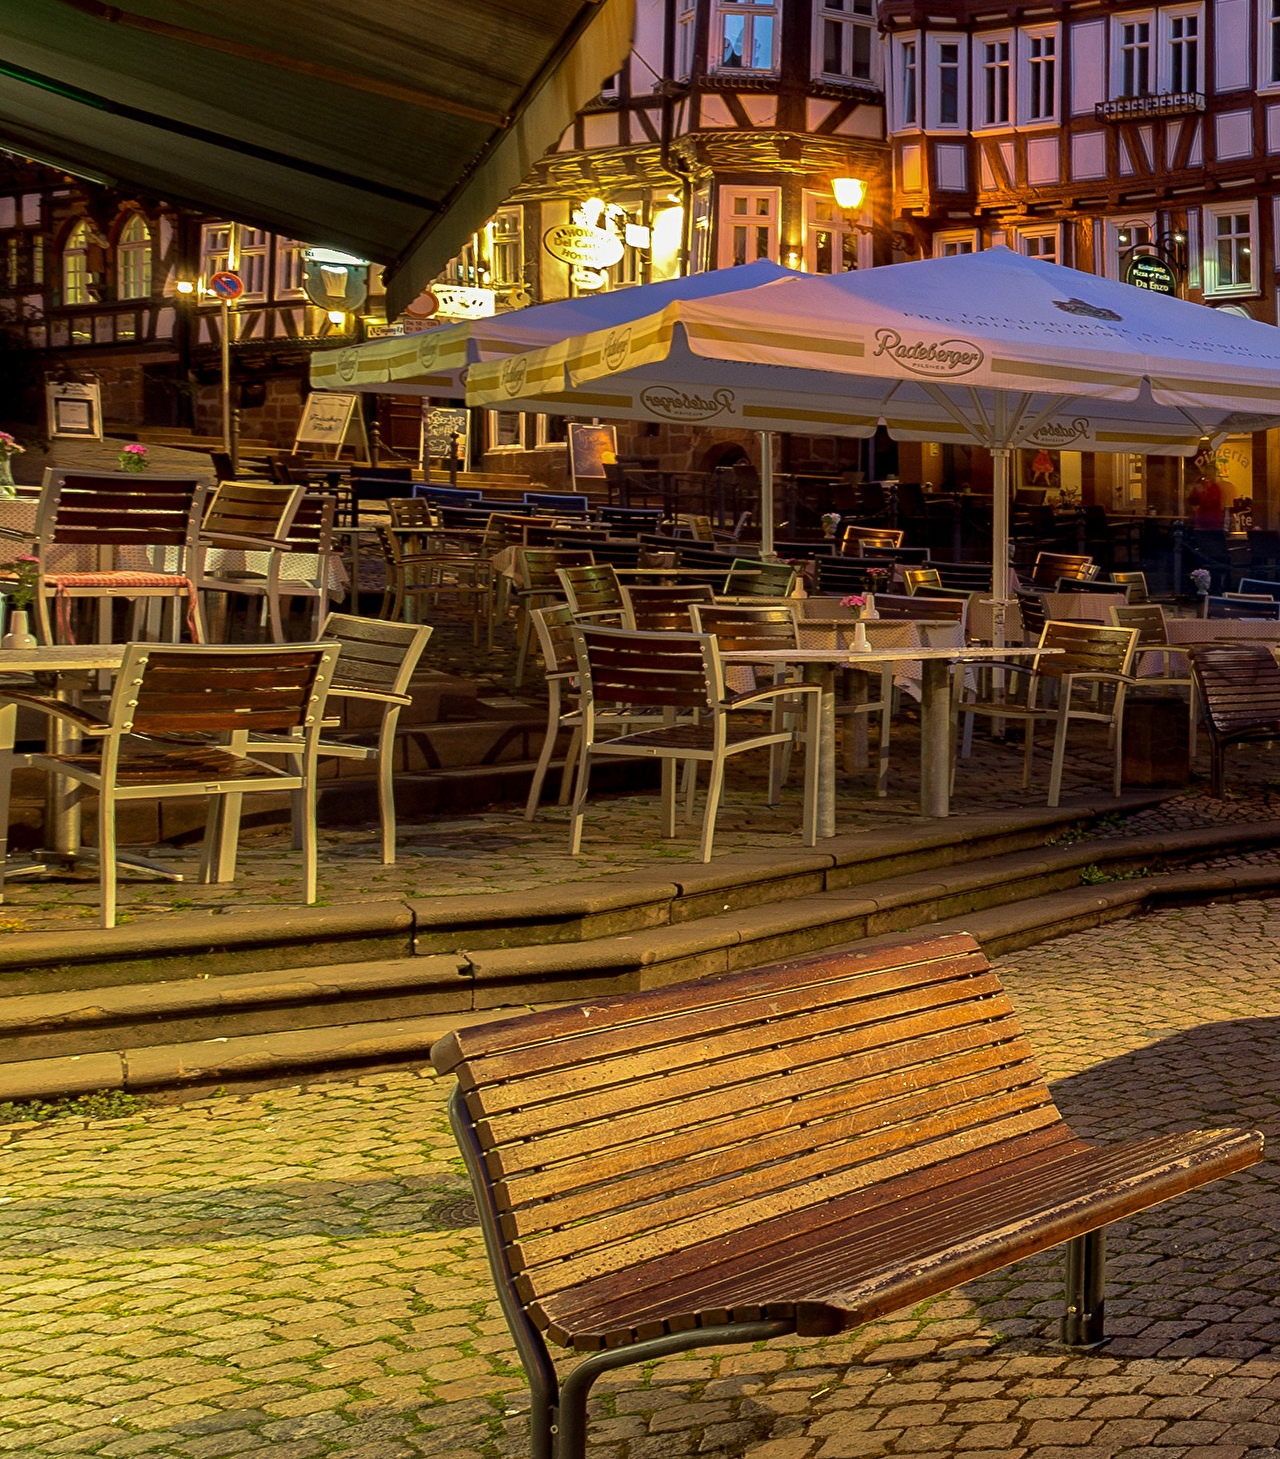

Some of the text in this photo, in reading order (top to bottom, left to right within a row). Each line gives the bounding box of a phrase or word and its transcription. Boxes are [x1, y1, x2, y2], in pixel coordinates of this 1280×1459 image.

[1136, 279, 1169, 292] Da Enzo
[873, 328, 982, 373] Radeberger
[912, 363, 946, 371] PILSNER
